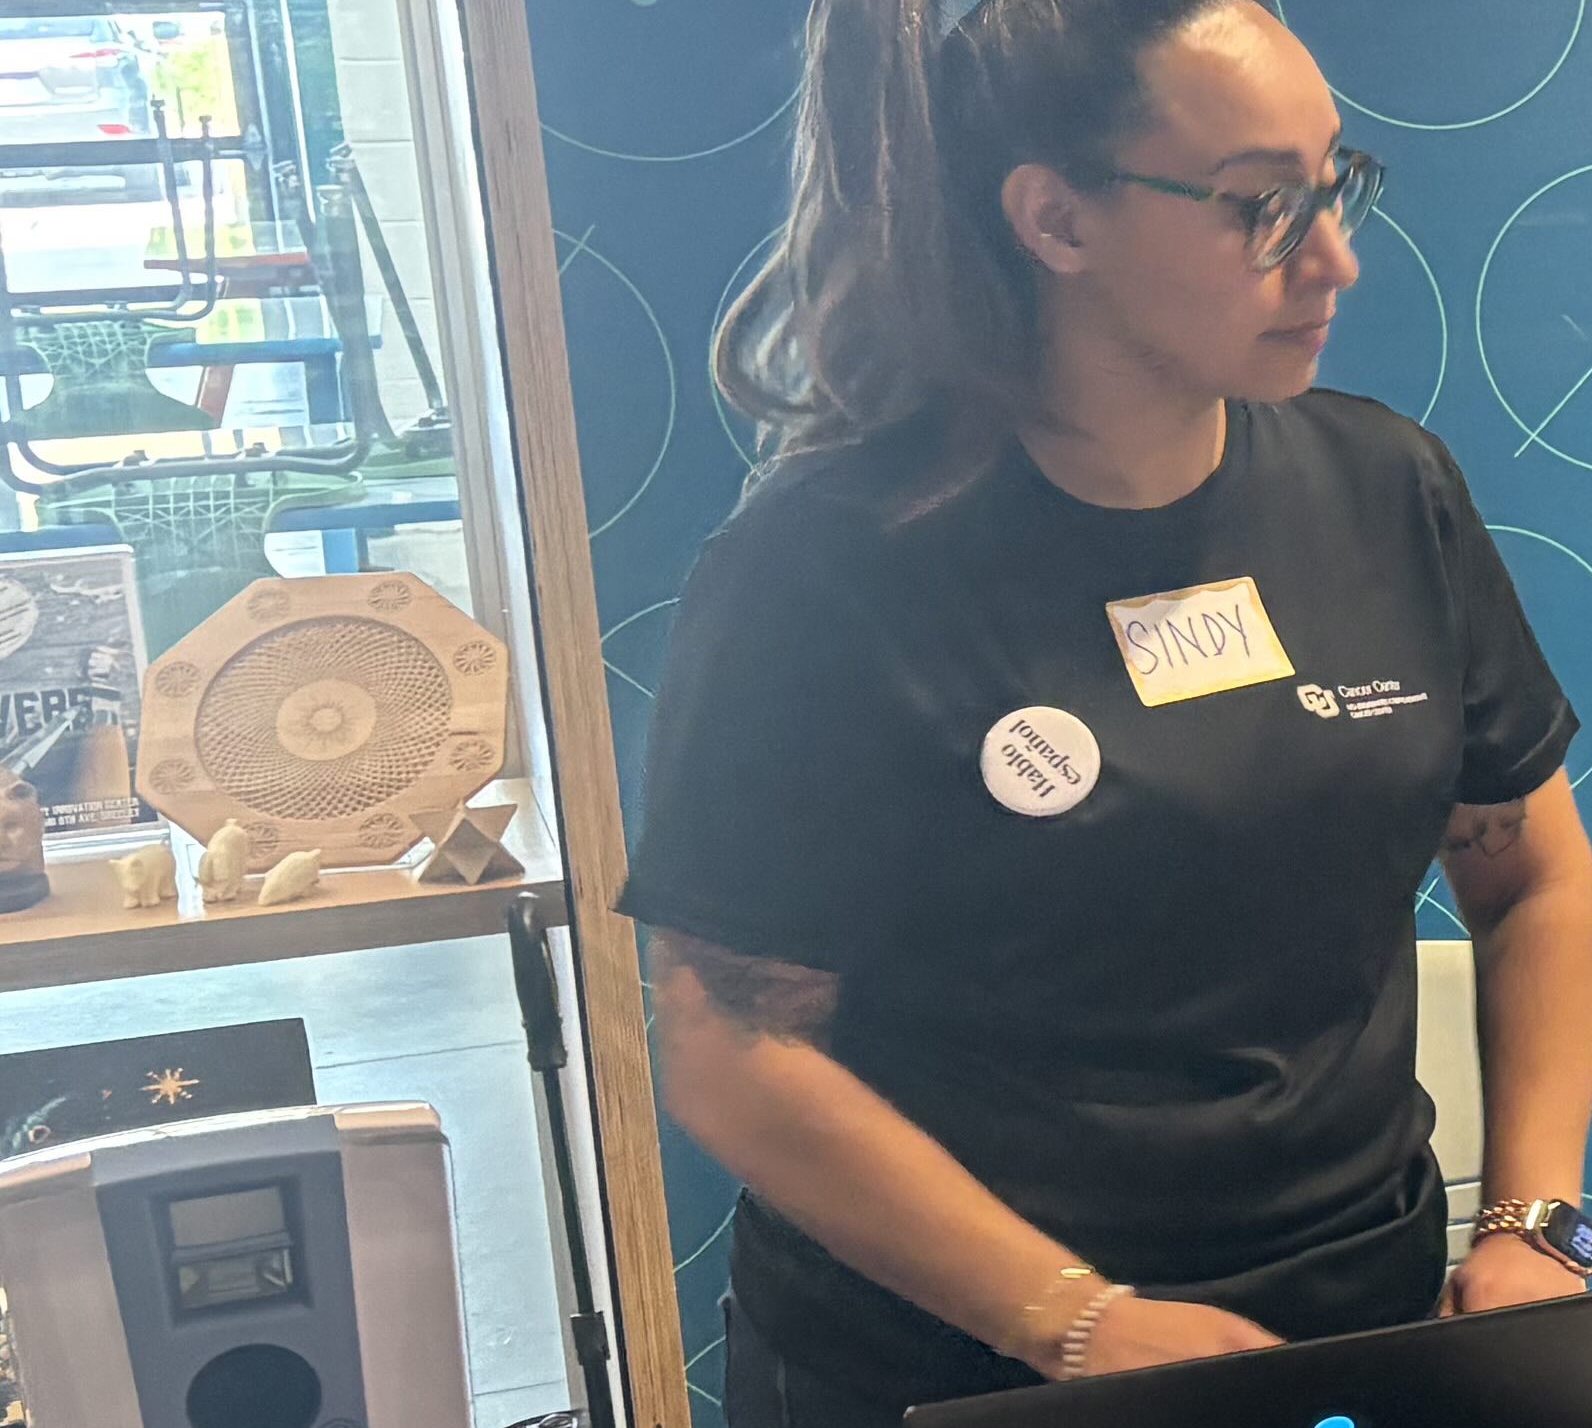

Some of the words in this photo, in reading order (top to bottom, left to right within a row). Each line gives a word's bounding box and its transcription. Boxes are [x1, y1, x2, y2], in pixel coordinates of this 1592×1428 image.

[1126, 604, 1252, 676] SINDY
[1000, 742, 1056, 799] Hablo
[1008, 718, 1081, 787] español
